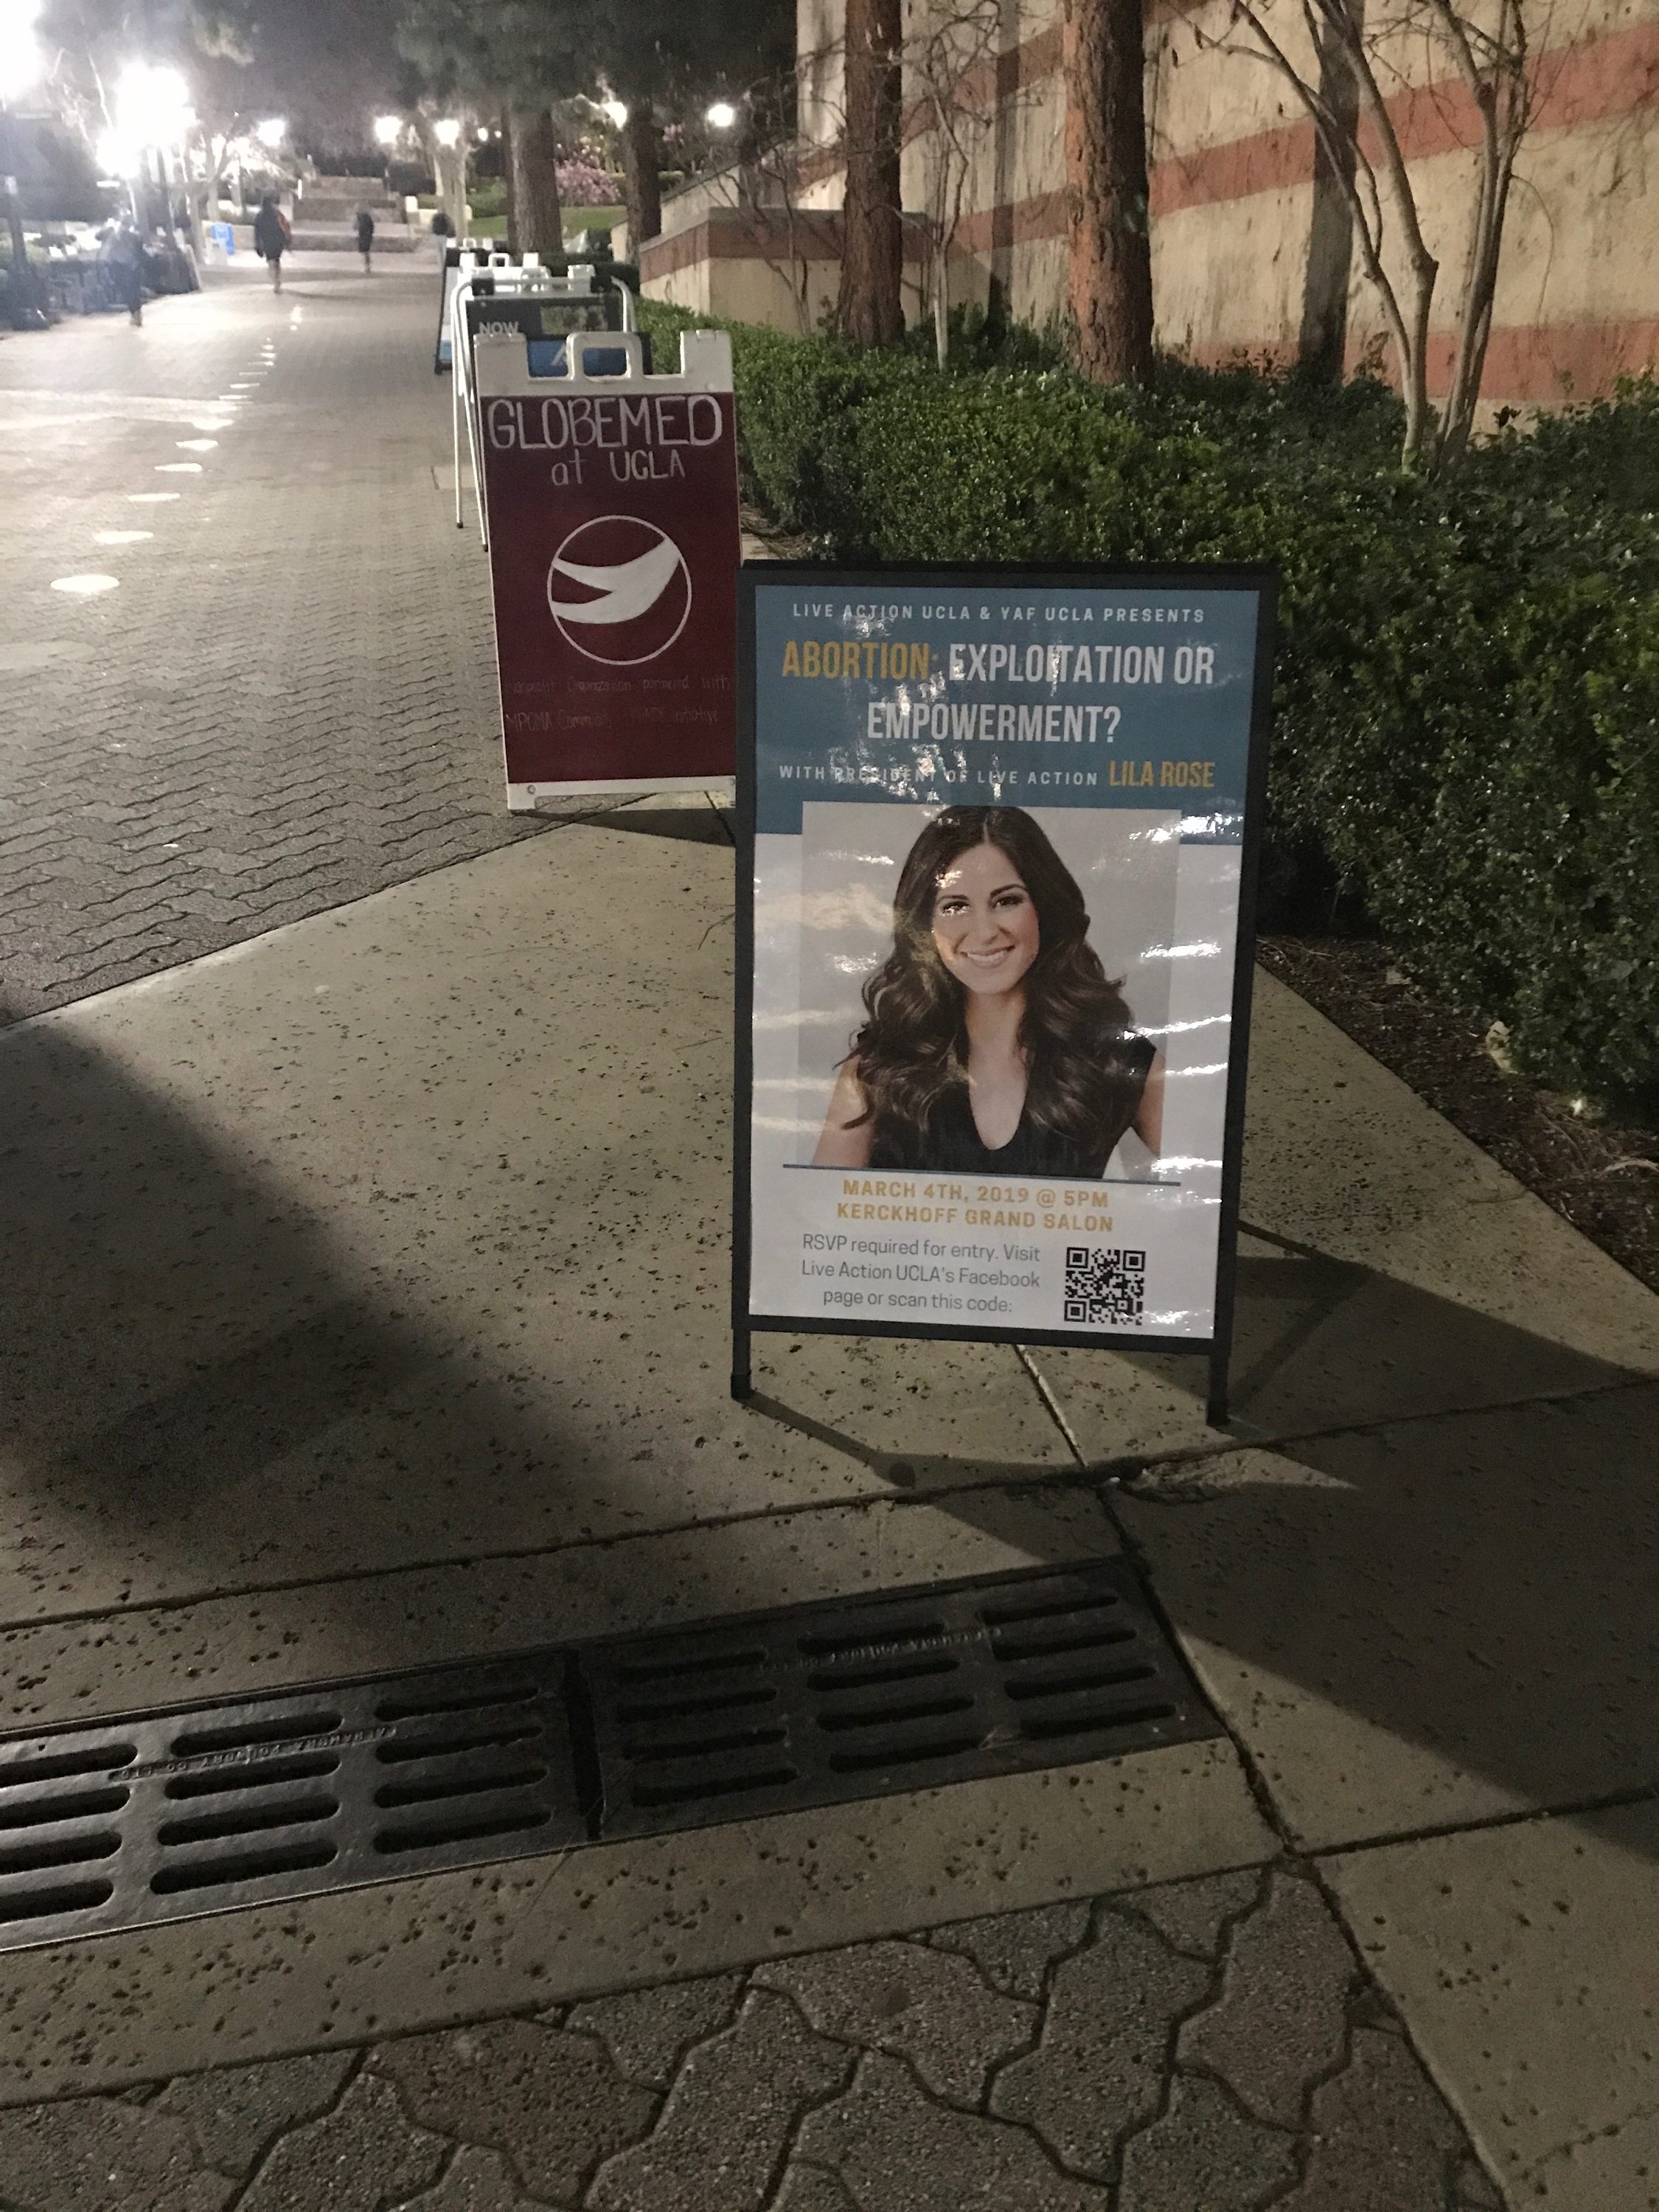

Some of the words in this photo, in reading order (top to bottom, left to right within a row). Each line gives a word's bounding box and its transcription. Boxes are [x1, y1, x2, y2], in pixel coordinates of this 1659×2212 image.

[479, 321, 519, 335] NOW
[487, 394, 723, 450] GLOBEMED
[551, 448, 586, 486] at
[793, 603, 833, 618] LIVE
[844, 604, 913, 619] ACTION
[922, 605, 970, 620] UCLA
[979, 606, 990, 621] &
[1001, 607, 1036, 621] YAF
[1045, 607, 1094, 622] UCLA
[1103, 608, 1204, 623] PRESENTS
[948, 642, 1165, 684] EXPLOITATION
[1174, 645, 1215, 685] OR
[867, 701, 1121, 743] EMPOWERMENT?
[779, 765, 825, 779] WITH
[834, 766, 936, 782] PRESIDENT
[948, 769, 969, 783] OF
[978, 770, 1018, 784] LIVE
[1027, 771, 1098, 786] ACTION
[1109, 760, 1155, 787] LILA
[1160, 761, 1216, 787] ROSE
[843, 1179, 916, 1198] MARCH
[923, 1183, 969, 1203] 4TH,
[977, 1185, 1029, 1203] 2019
[1037, 1188, 1055, 1208] @
[1064, 1190, 1109, 1208] 5PM
[838, 1203, 958, 1224] KERCKHOFF
[965, 1208, 1036, 1228] GRAND
[1043, 1213, 1113, 1232] SALON
[803, 1233, 848, 1251] RSVP
[851, 1238, 919, 1256] required
[923, 1239, 946, 1257] for
[950, 1243, 998, 1262] entry.
[1004, 1244, 1041, 1262] Visit
[802, 1259, 835, 1277] Live
[838, 1261, 891, 1280] Action
[896, 1265, 955, 1283] UCLA's
[959, 1267, 1040, 1288] Facebook
[823, 1290, 863, 1307] page
[867, 1292, 884, 1305] or
[888, 1293, 927, 1308] scan
[931, 1293, 962, 1310] this
[967, 1295, 1012, 1312] code:
